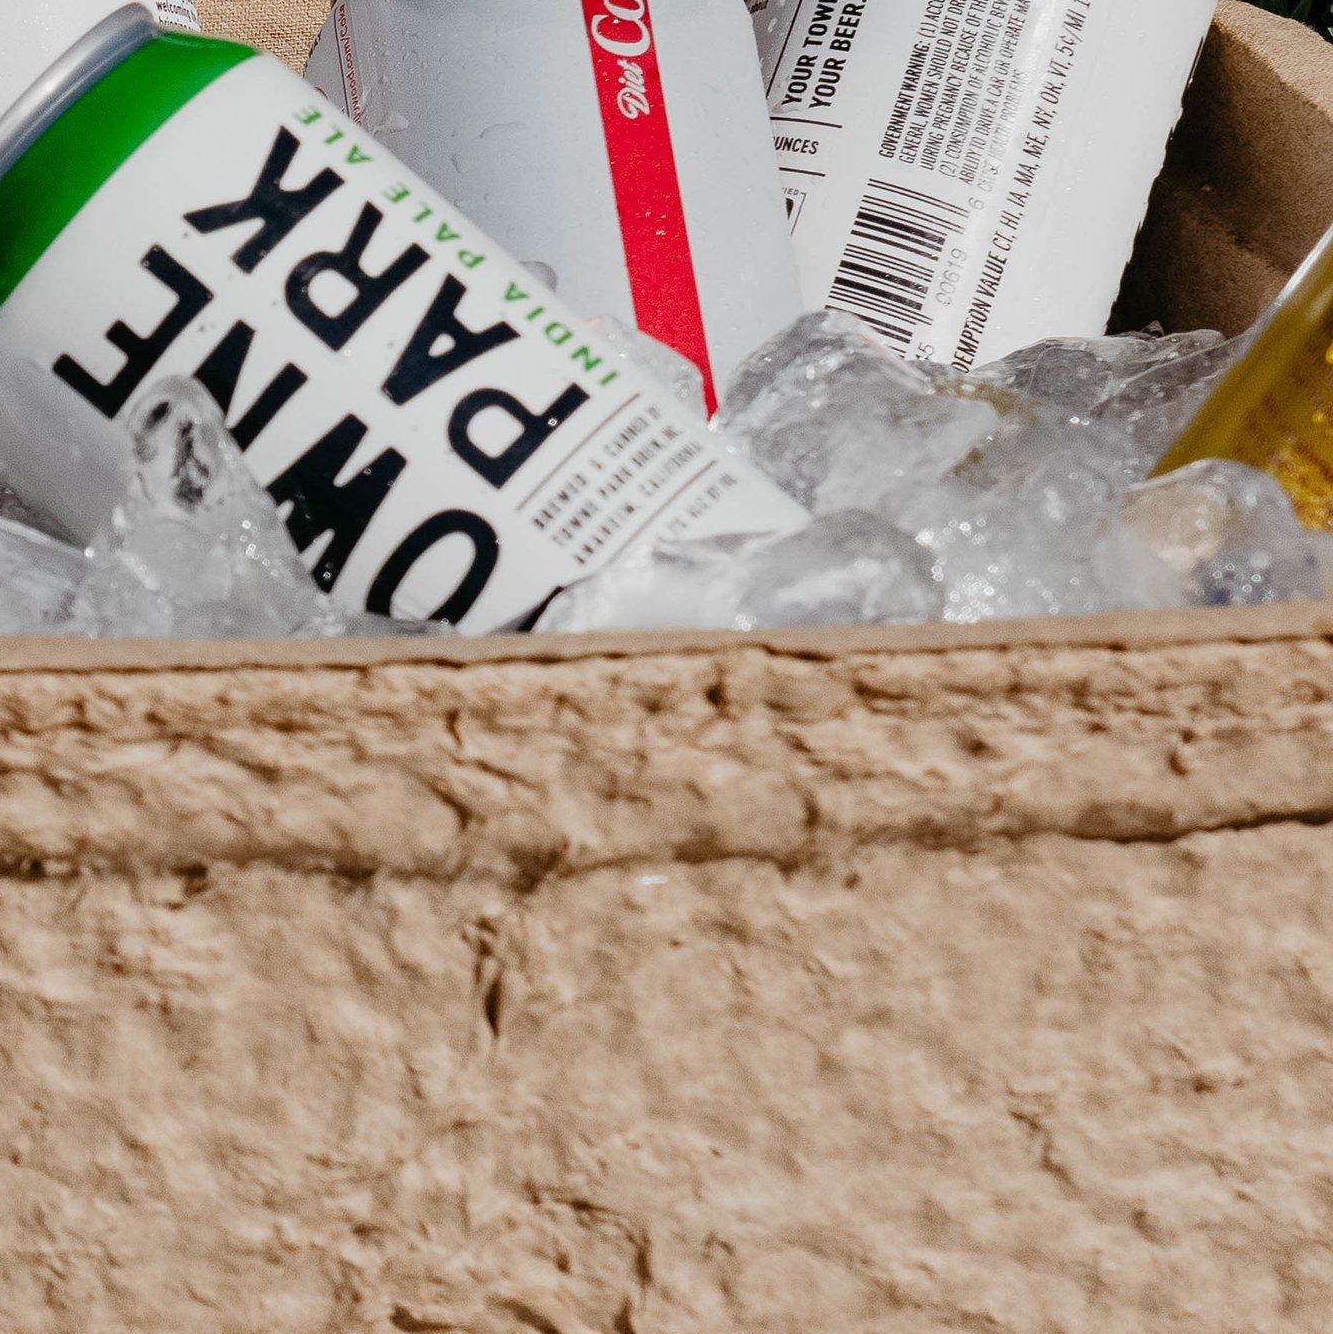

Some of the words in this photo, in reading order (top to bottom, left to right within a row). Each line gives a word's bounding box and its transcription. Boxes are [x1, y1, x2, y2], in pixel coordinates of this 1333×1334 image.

[940, 14, 961, 37] NOT
[965, 12, 983, 28] OF
[997, 13, 1026, 59] OPERATE
[926, 37, 954, 80] SHOULD
[950, 27, 979, 73] BECAUSE
[971, 18, 1004, 75] ALCOHOLIC
[616, 58, 650, 121] Diet
[781, 50, 818, 111] YOUR
[808, 53, 846, 113] YOUR
[877, 91, 914, 159] GOVERNMENT
[900, 38, 931, 93] WARNING:
[917, 20, 939, 40] (1)
[913, 77, 940, 119] WOMEN
[931, 72, 965, 131] PREGNANCY
[966, 72, 985, 89] OF
[985, 74, 1005, 97] CAR
[293, 105, 375, 167] ALE
[943, 88, 981, 160] CONSUMPTION
[973, 103, 997, 136] DRIVE
[1030, 104, 1057, 129] NY,
[773, 136, 819, 155] UNCES
[898, 116, 929, 165] GENERAL,
[918, 130, 945, 170] DURING
[969, 134, 986, 150] TO
[1021, 129, 1050, 159] ME,
[1012, 158, 1039, 187] MA,
[380, 181, 486, 271] PALE
[997, 207, 1023, 230] HI,
[975, 250, 1008, 298] VALUE
[183, 125, 591, 489] PARK
[501, 279, 623, 387] INDIA
[949, 297, 992, 374] DEMPTION
[53, 244, 561, 634] OWNE
